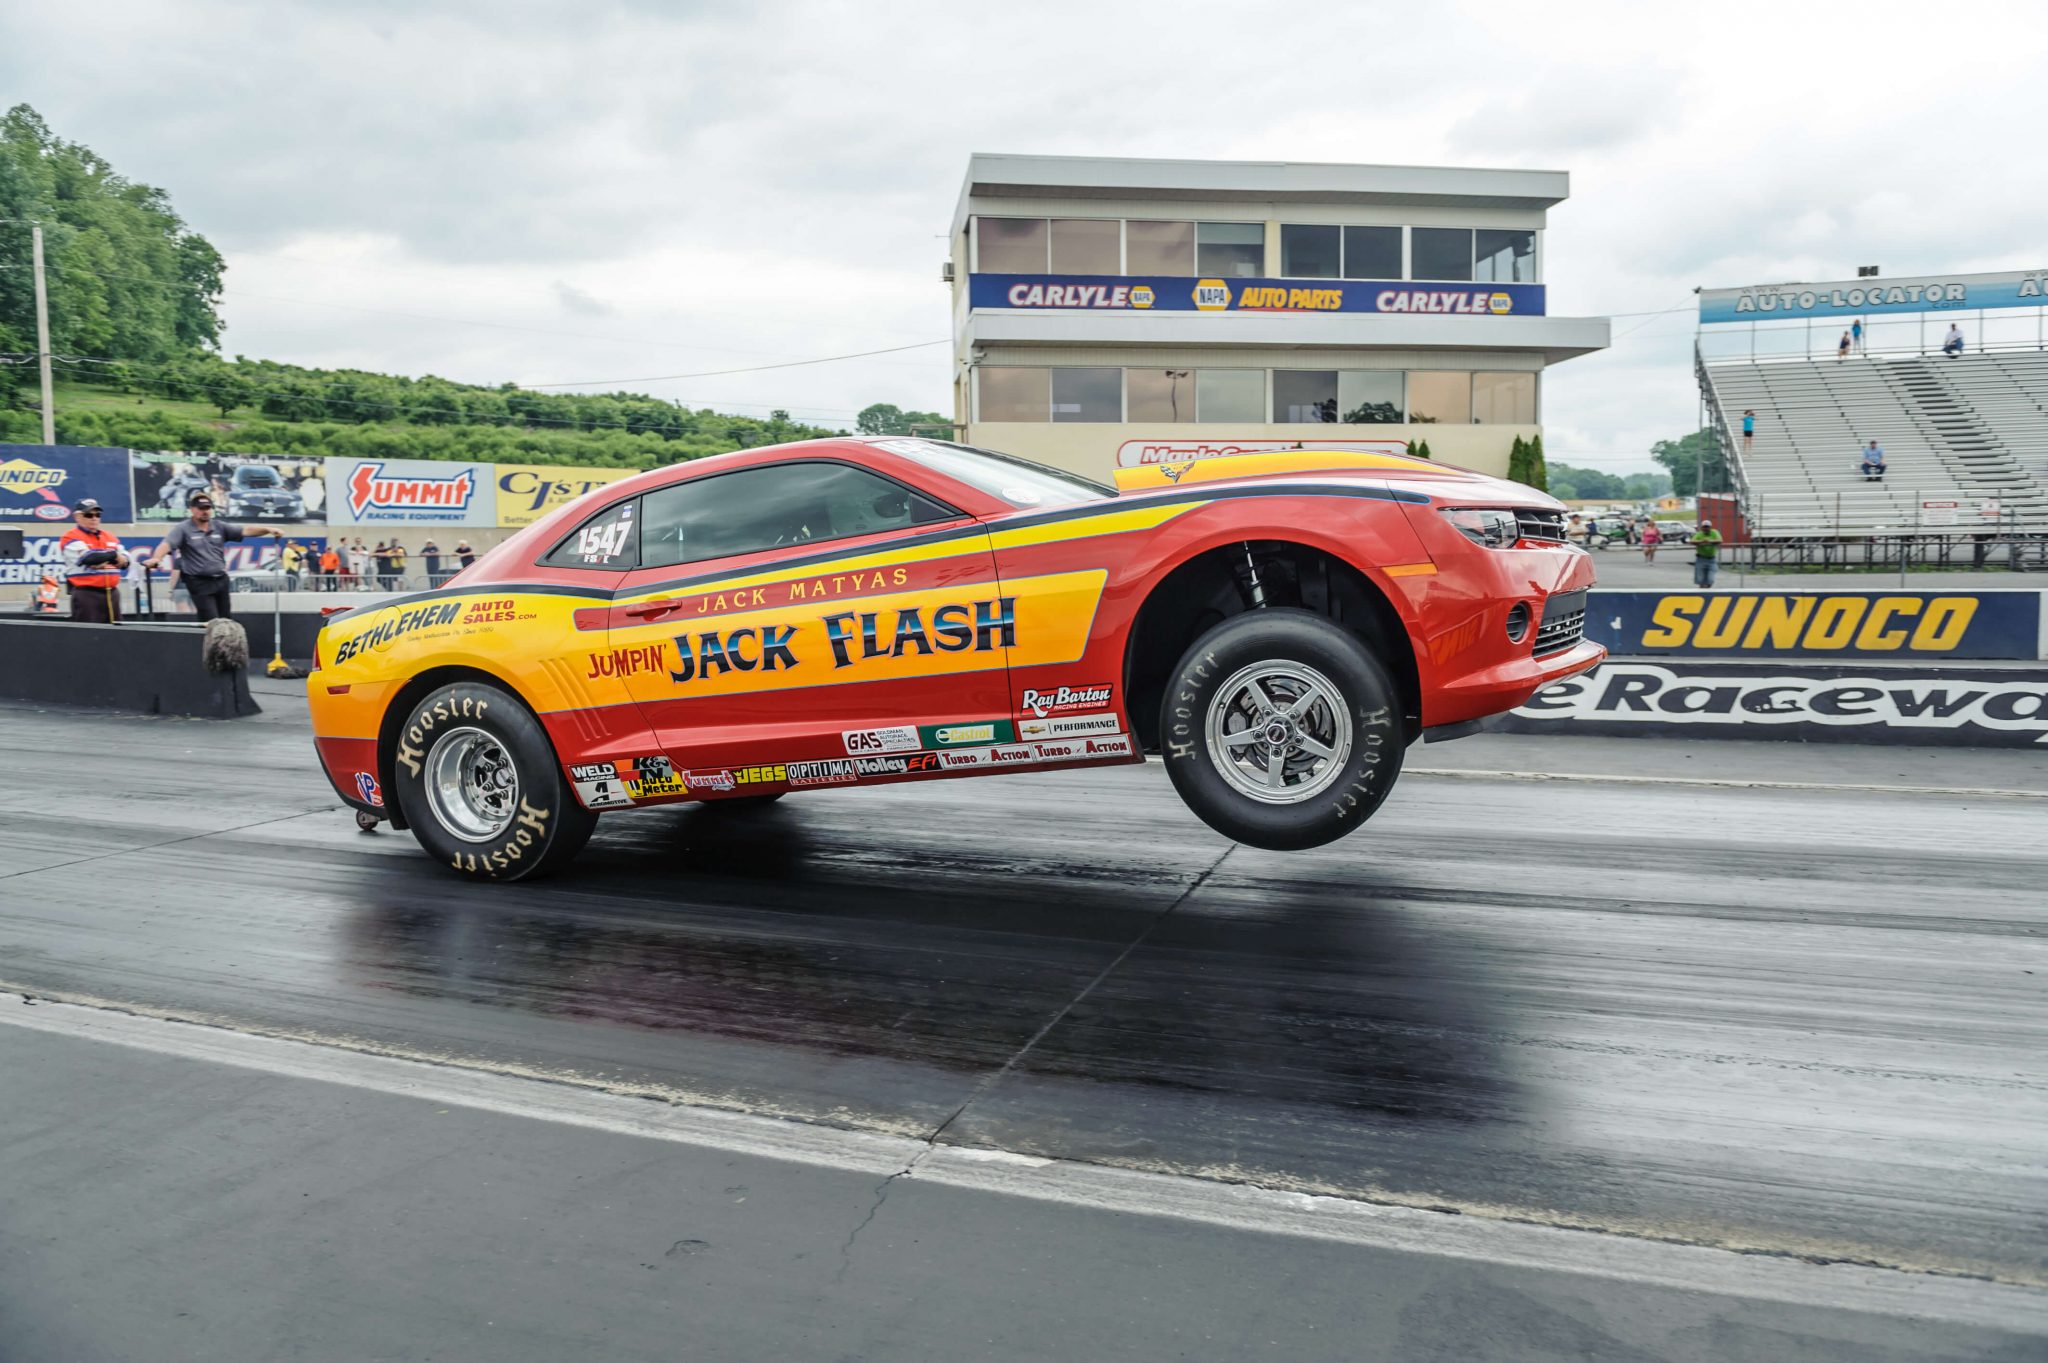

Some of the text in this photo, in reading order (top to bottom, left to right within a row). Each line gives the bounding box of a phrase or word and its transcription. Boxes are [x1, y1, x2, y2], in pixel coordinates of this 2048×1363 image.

[1008, 285, 1130, 308] CARLYLE
[1199, 287, 1343, 310] NAPA AUTO PARTS
[1376, 290, 1490, 313] CARLYLE
[1734, 283, 1967, 313] AUTO-LOCATOR
[499, 471, 572, 511] CJ's
[408, 513, 466, 521] EQUIPMENT
[578, 520, 633, 557] 1547
[697, 568, 908, 614] JACK MATYAS
[470, 599, 515, 613] AUTO
[463, 610, 516, 626] SALES
[1641, 595, 1979, 651] SUNOCO
[335, 602, 462, 666] BETHLEHEM
[587, 595, 1021, 685] JUMPIN' JACK FLASH
[1022, 685, 1111, 718] Ray Barton
[1168, 651, 1218, 761] Hoosier
[1577, 665, 2048, 736] Racewa
[397, 688, 489, 780] Hoosier
[950, 726, 991, 741] Castrol
[1053, 719, 1117, 733] PERFORMANCE
[847, 731, 884, 750] GAS
[1034, 744, 1072, 758] TURBO
[1085, 739, 1128, 754] ACTION
[855, 756, 908, 774] Holley
[941, 752, 977, 766] TURBO
[991, 747, 1031, 762] ACTION
[1332, 705, 1393, 819] Hoosier
[571, 764, 615, 778] WELD
[736, 765, 787, 784] JEGS
[788, 759, 854, 779] OPTIMA
[642, 783, 683, 797] Meter
